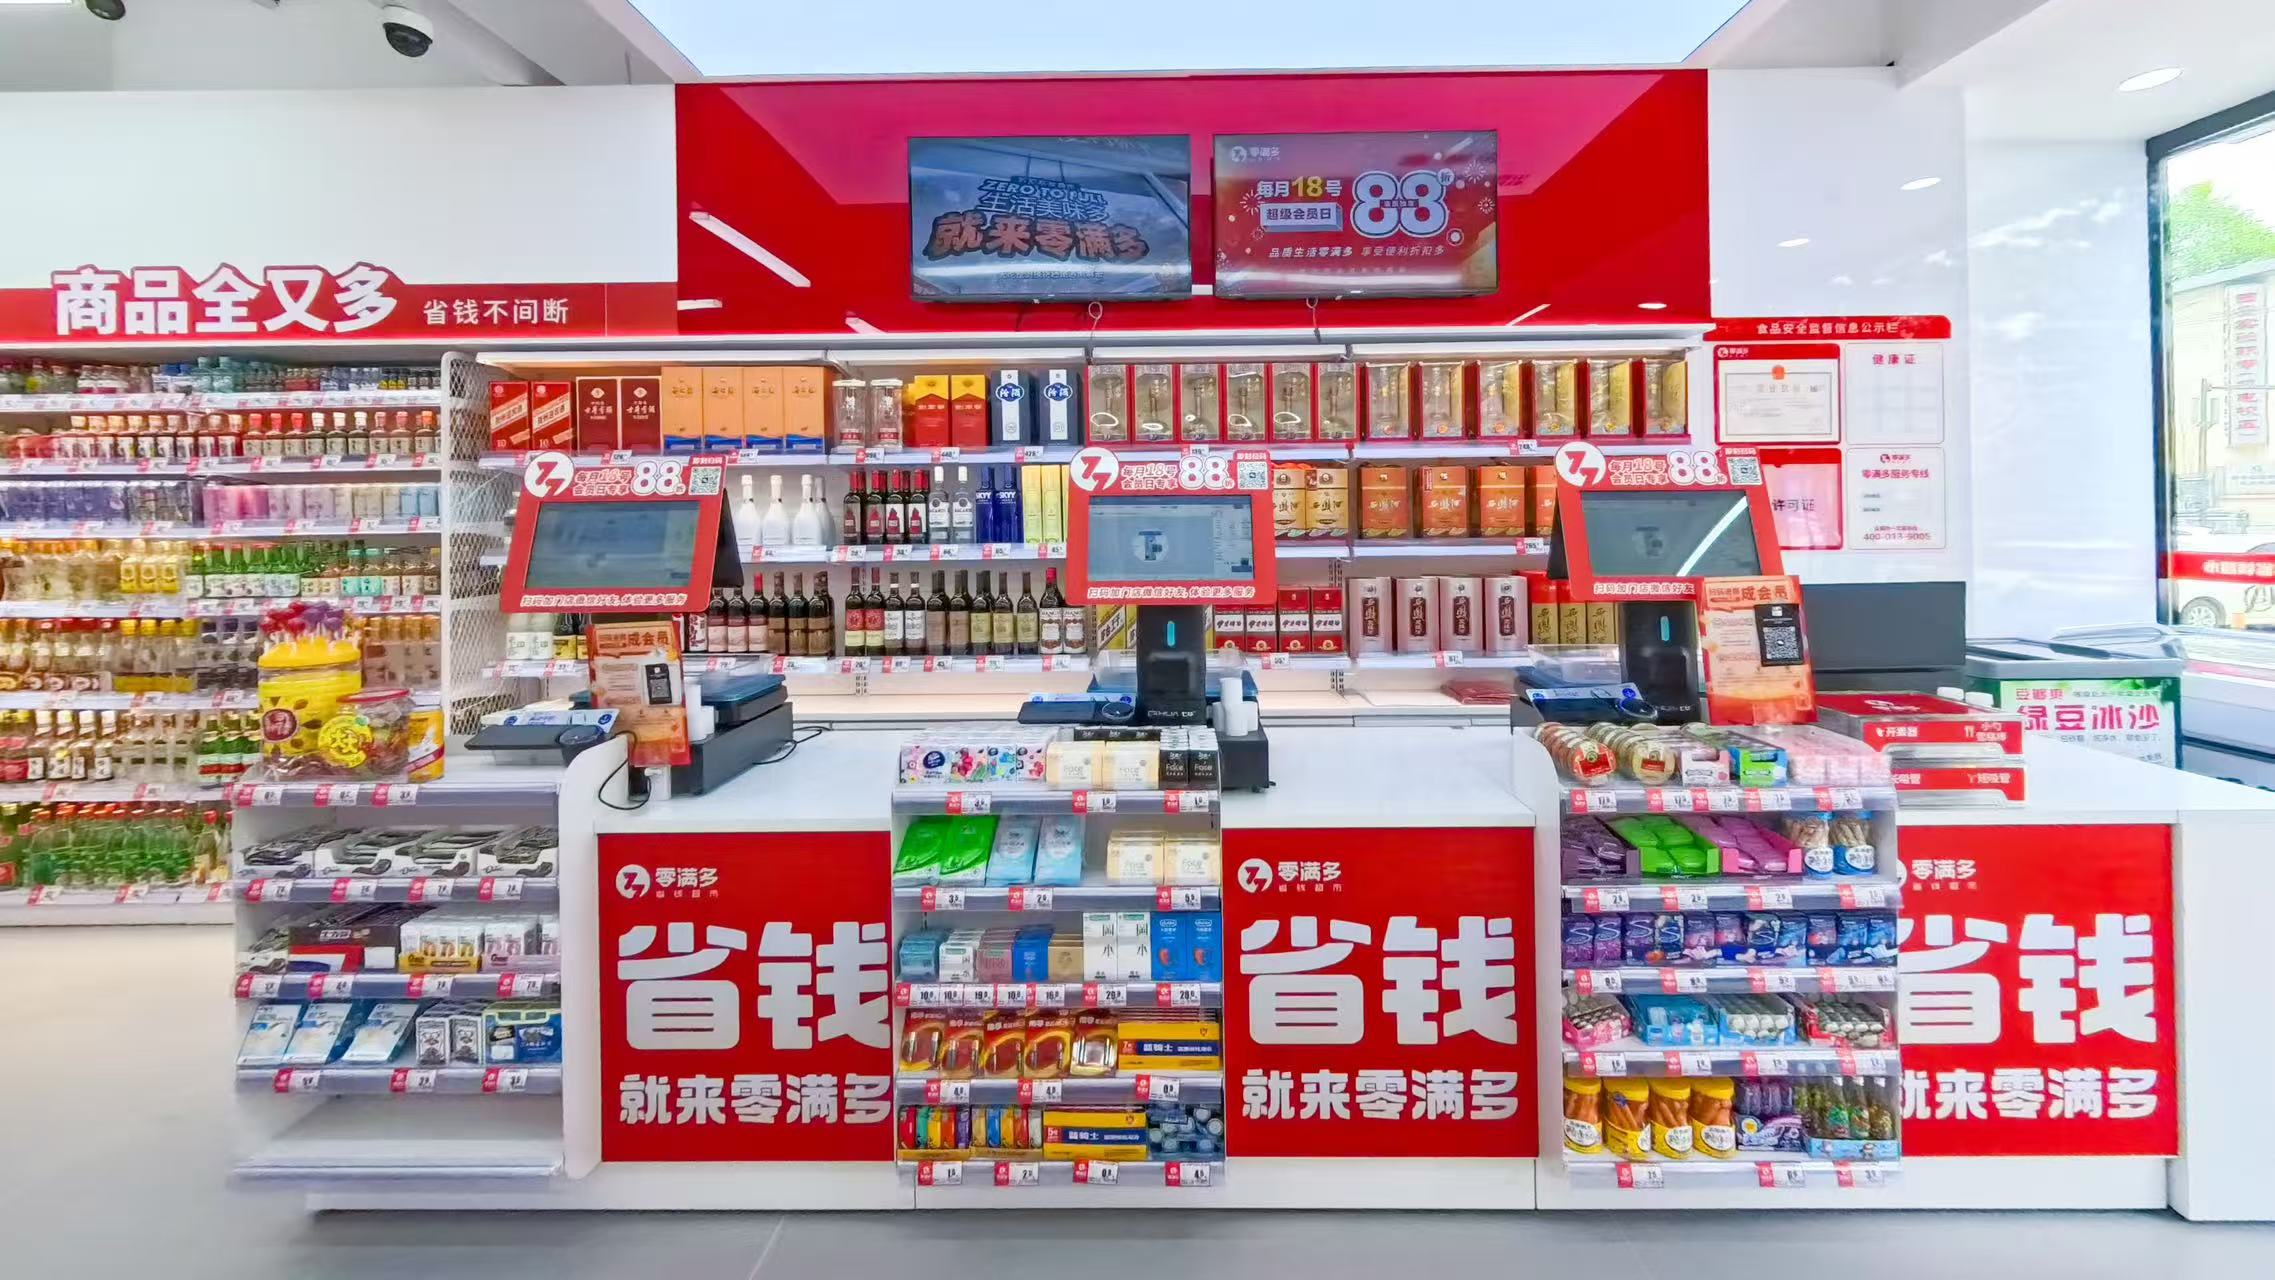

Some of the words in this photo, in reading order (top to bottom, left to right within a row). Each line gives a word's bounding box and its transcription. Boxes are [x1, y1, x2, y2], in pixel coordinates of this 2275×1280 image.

[1257, 176, 1343, 198] 每月18号
[978, 191, 1110, 221] 生活美味多
[1266, 207, 1332, 221] 超级会员日
[930, 212, 1149, 260] 就来零满多
[1268, 247, 1353, 258] 品质生活零满多
[57, 267, 397, 335] 商品全又多
[423, 298, 569, 325] 省钱不间断
[1757, 323, 1898, 335] 食品安全监督信息公示栏
[1121, 477, 1179, 489] 会员日专享
[1772, 499, 1815, 512] 许可证
[1741, 585, 1789, 601] 成会员
[628, 631, 671, 647] 成会员
[2017, 704, 2160, 731] 绿豆冰沙
[656, 867, 718, 888] 零满多
[1278, 861, 1342, 882] 零满多
[1912, 859, 1976, 880] 零满多
[1279, 883, 1342, 892] 省钱超市
[617, 921, 891, 1050] 省钱
[1240, 915, 1518, 1045] 省钱
[1898, 914, 2157, 1044] 省钱
[619, 1072, 892, 1125] 就来零满多
[1242, 1068, 1518, 1120] 就来零满多
